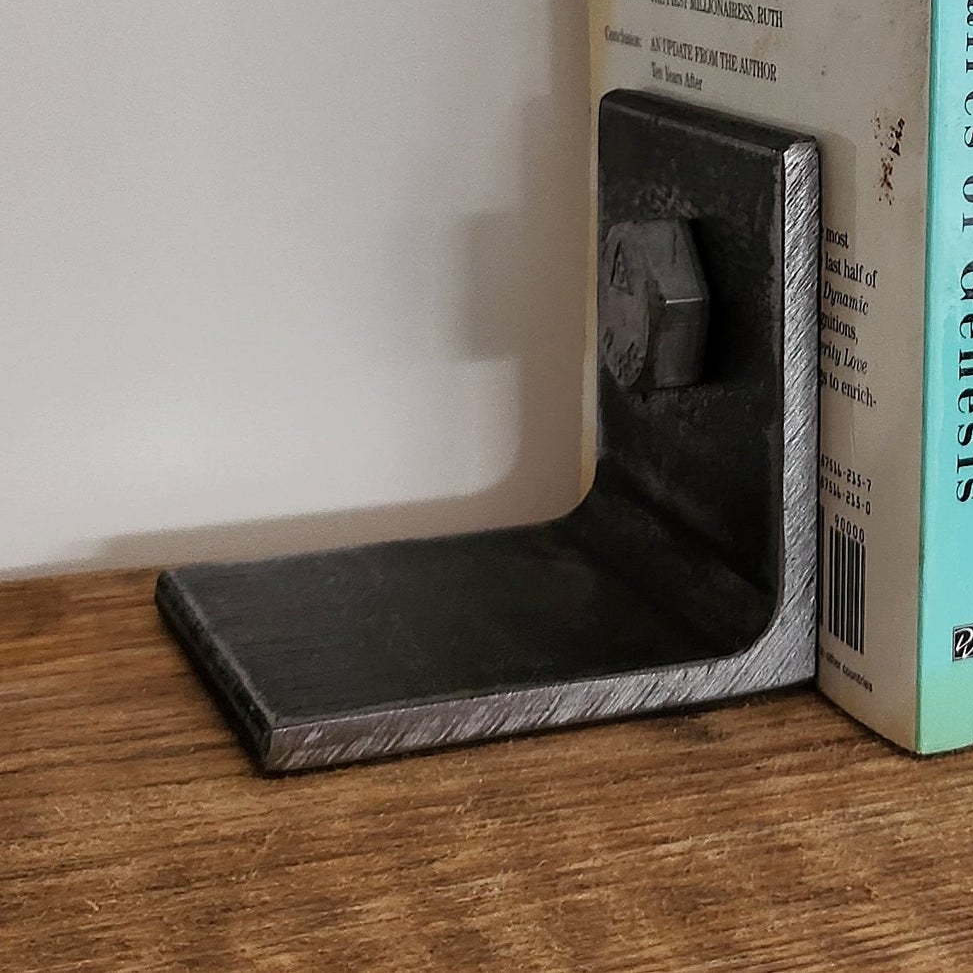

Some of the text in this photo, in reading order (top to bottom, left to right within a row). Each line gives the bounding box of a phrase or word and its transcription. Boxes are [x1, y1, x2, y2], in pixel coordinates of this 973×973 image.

[757, 7, 783, 28] RUTH
[650, 38, 661, 52] AN
[663, 39, 693, 62] UPDATE
[695, 46, 718, 68] FROM
[720, 52, 737, 71] THE
[739, 57, 776, 81] AUTHOR
[665, 64, 682, 84] Years
[685, 72, 702, 90] After
[826, 228, 849, 248] most
[825, 251, 878, 288] last half of
[824, 281, 869, 316] Dynamic
[844, 348, 867, 374] Love
[830, 372, 838, 391] to
[842, 382, 876, 407] enrich-
[835, 514, 864, 543] 90000
